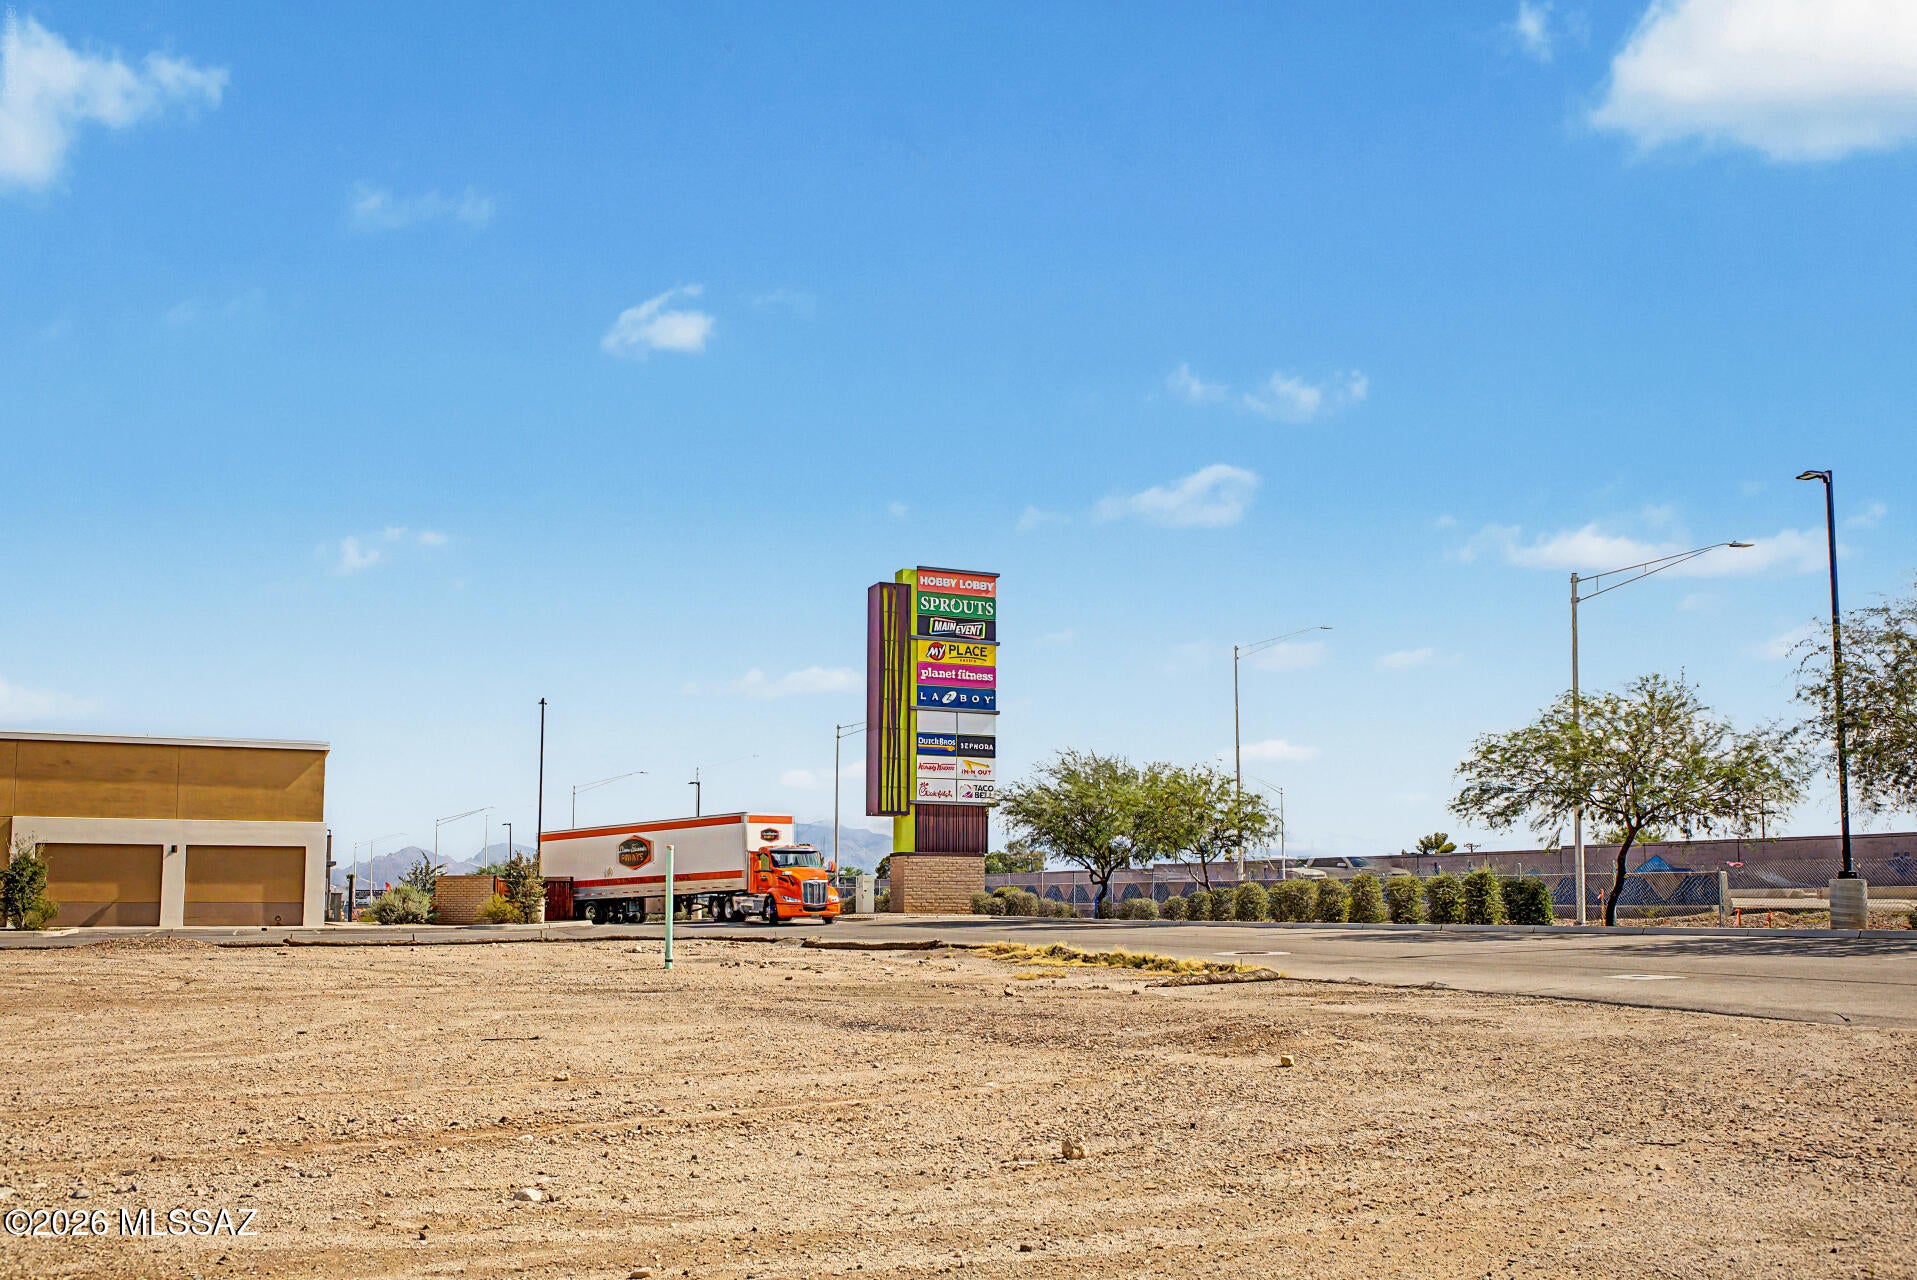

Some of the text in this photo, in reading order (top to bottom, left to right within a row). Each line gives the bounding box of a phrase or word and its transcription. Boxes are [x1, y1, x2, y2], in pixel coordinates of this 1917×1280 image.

[920, 576, 994, 591] HOBBY LOBBY
[920, 596, 994, 616] SPROUTS
[934, 620, 982, 636] MAIN EVENT
[949, 644, 988, 657] PLACE
[920, 668, 994, 681] planet fitness
[960, 742, 994, 750] SEPHORA
